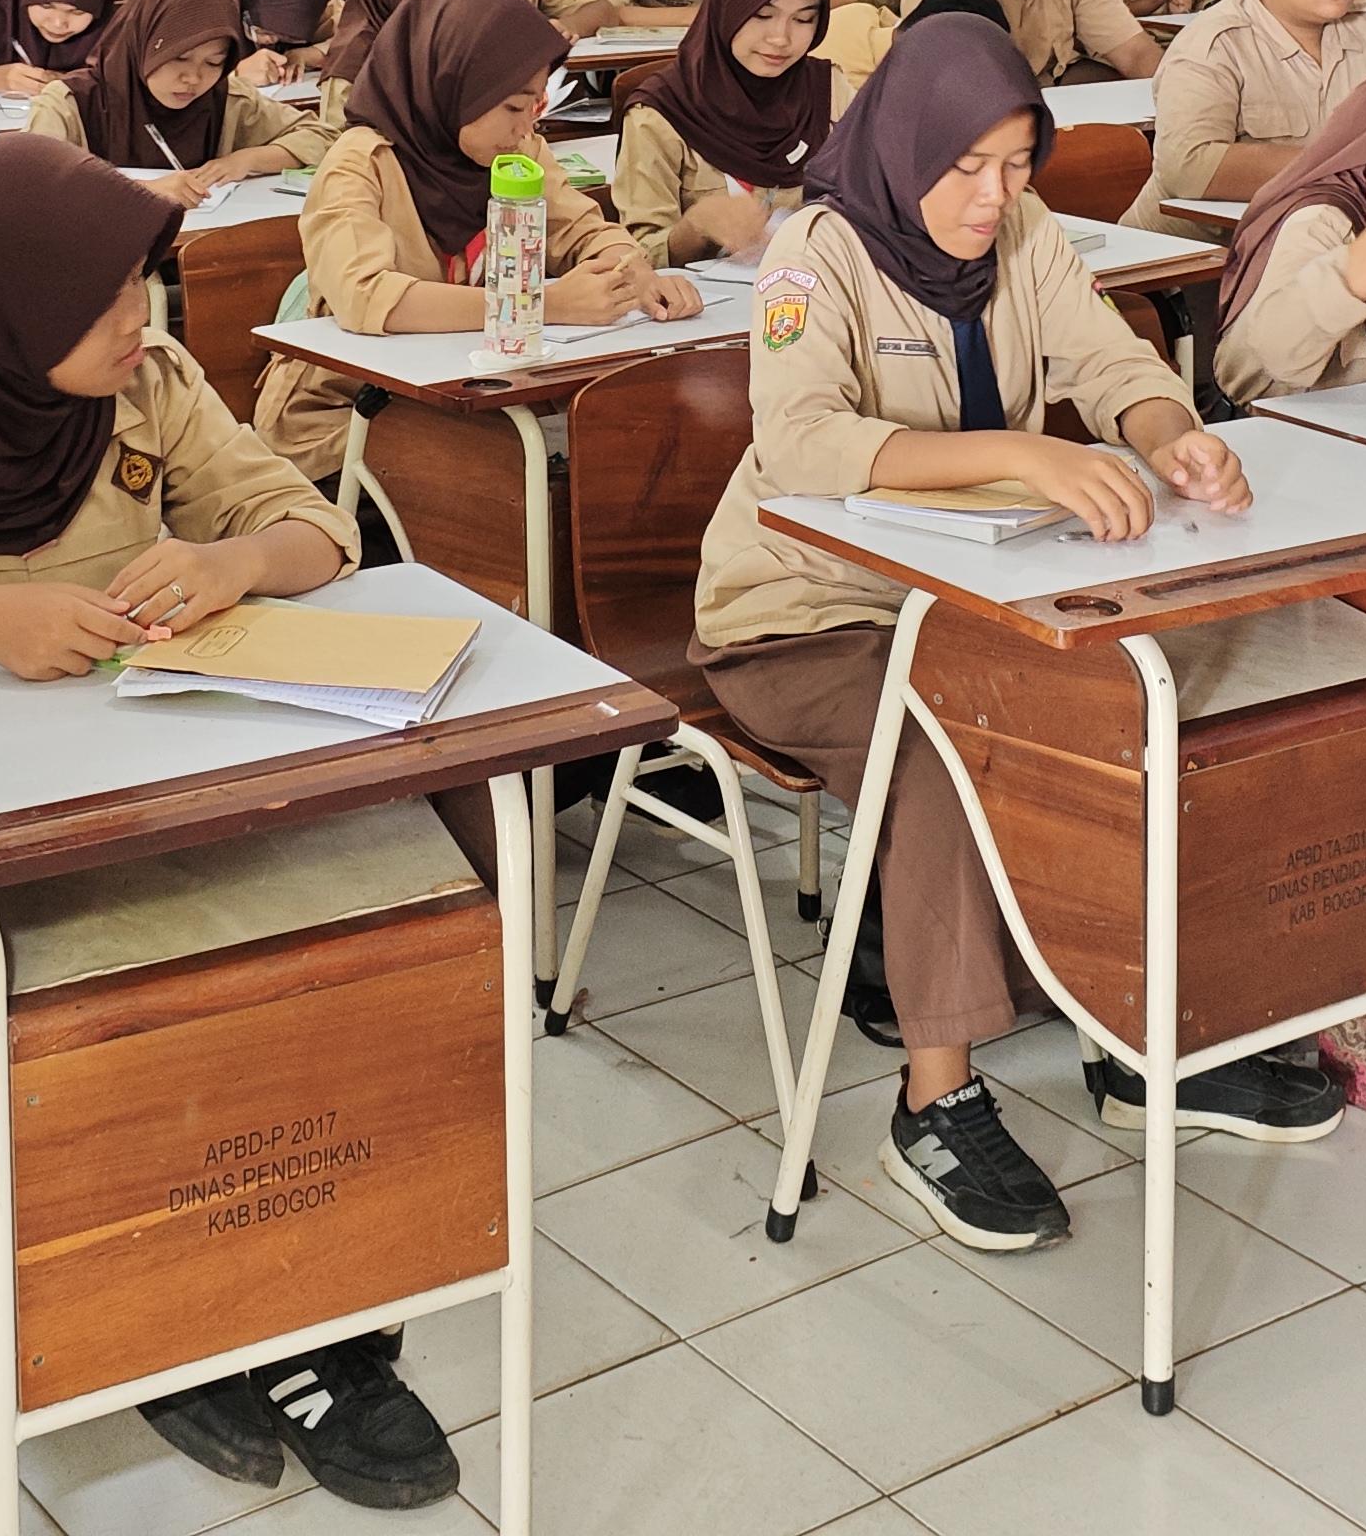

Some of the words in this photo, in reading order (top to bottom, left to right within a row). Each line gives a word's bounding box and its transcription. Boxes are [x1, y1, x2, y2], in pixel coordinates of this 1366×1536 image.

[782, 269, 813, 287] BOGOR
[1285, 843, 1324, 871] APBD
[1268, 876, 1309, 904] DINAS
[204, 1124, 286, 1169] APBD-P
[290, 1111, 338, 1147] 2017
[169, 1172, 237, 1213] DINAS
[242, 1136, 374, 1193] PENDIDIKAN
[207, 1181, 337, 1237] KAB.BOGOR
